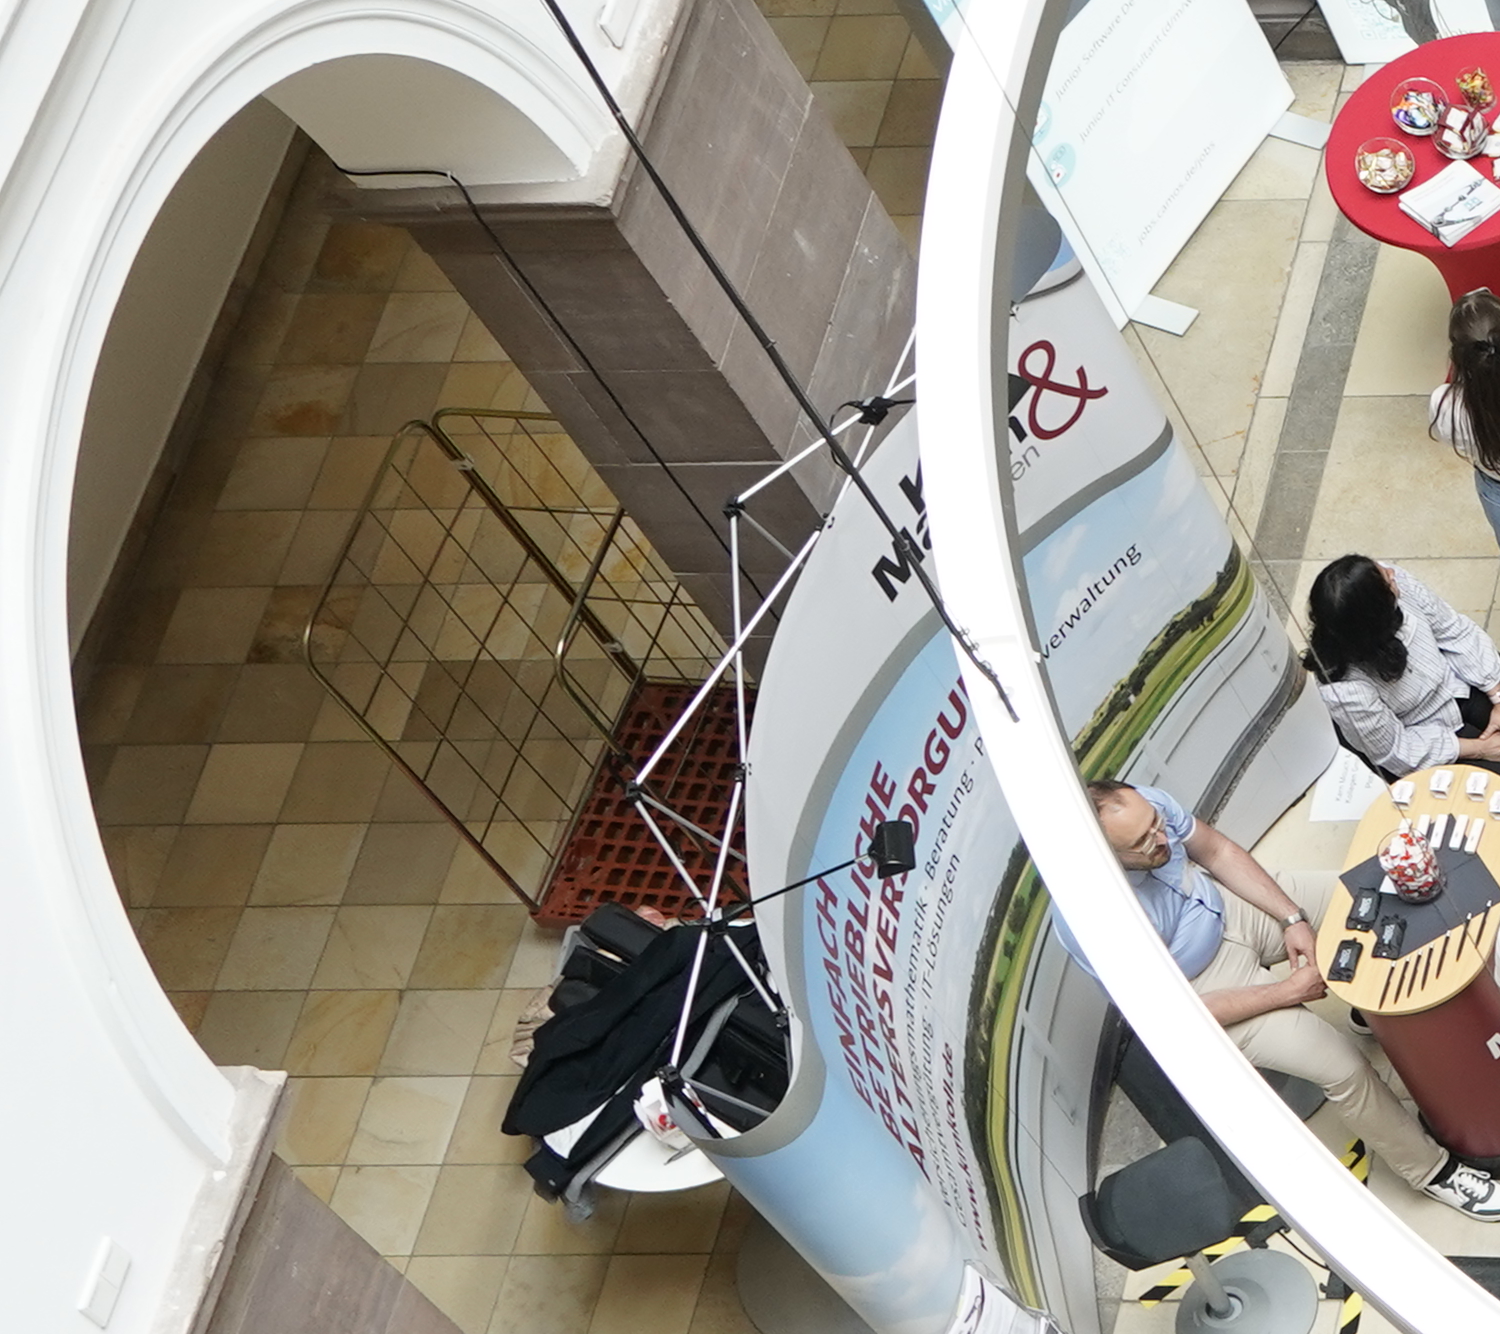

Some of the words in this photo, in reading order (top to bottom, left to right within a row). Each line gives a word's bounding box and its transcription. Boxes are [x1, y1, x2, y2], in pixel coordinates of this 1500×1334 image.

[1018, 339, 1109, 441] &
[1040, 543, 1143, 662] verwaltung
[924, 769, 975, 882] Beratung
[844, 760, 903, 1149] BETRIEBLICHE
[921, 852, 961, 1001] IT-Lösungen
[816, 877, 877, 1114] EINFACH
